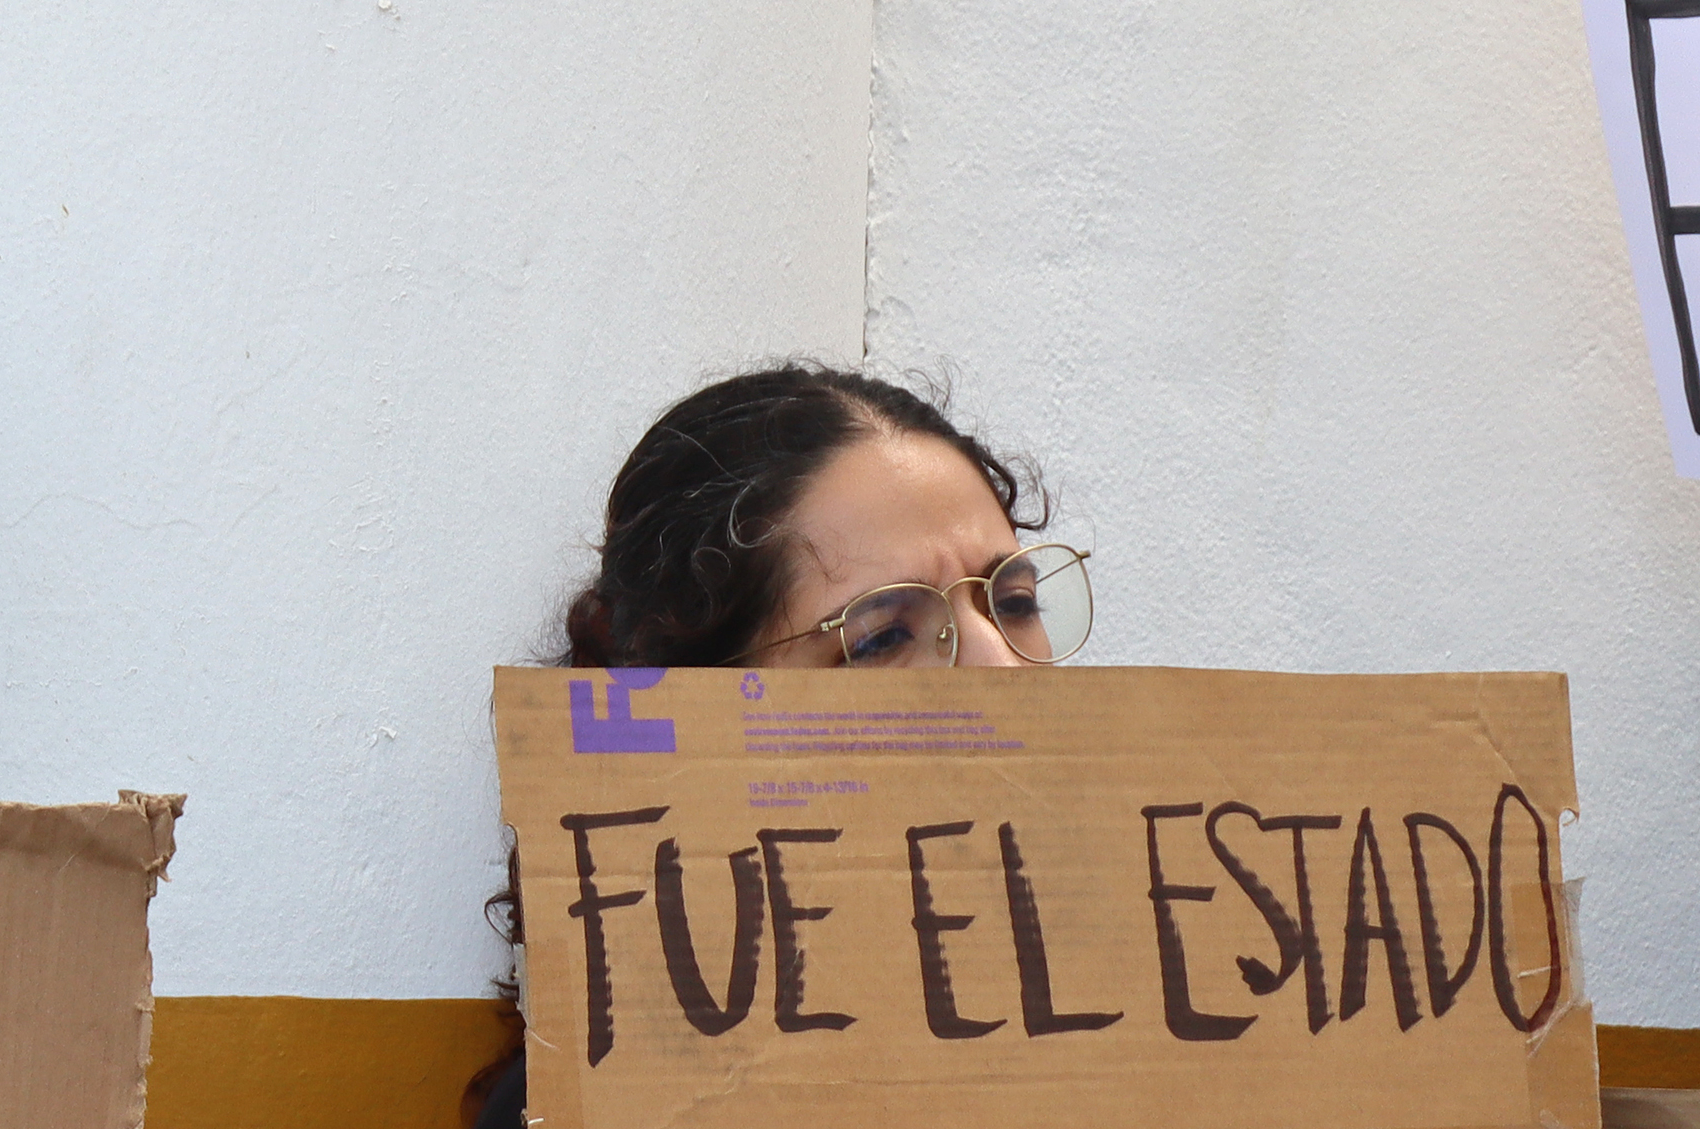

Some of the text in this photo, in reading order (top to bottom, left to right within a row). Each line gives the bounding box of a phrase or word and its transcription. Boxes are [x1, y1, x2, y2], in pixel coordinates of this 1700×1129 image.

[560, 784, 1561, 1068] FUE EL ESTADO
